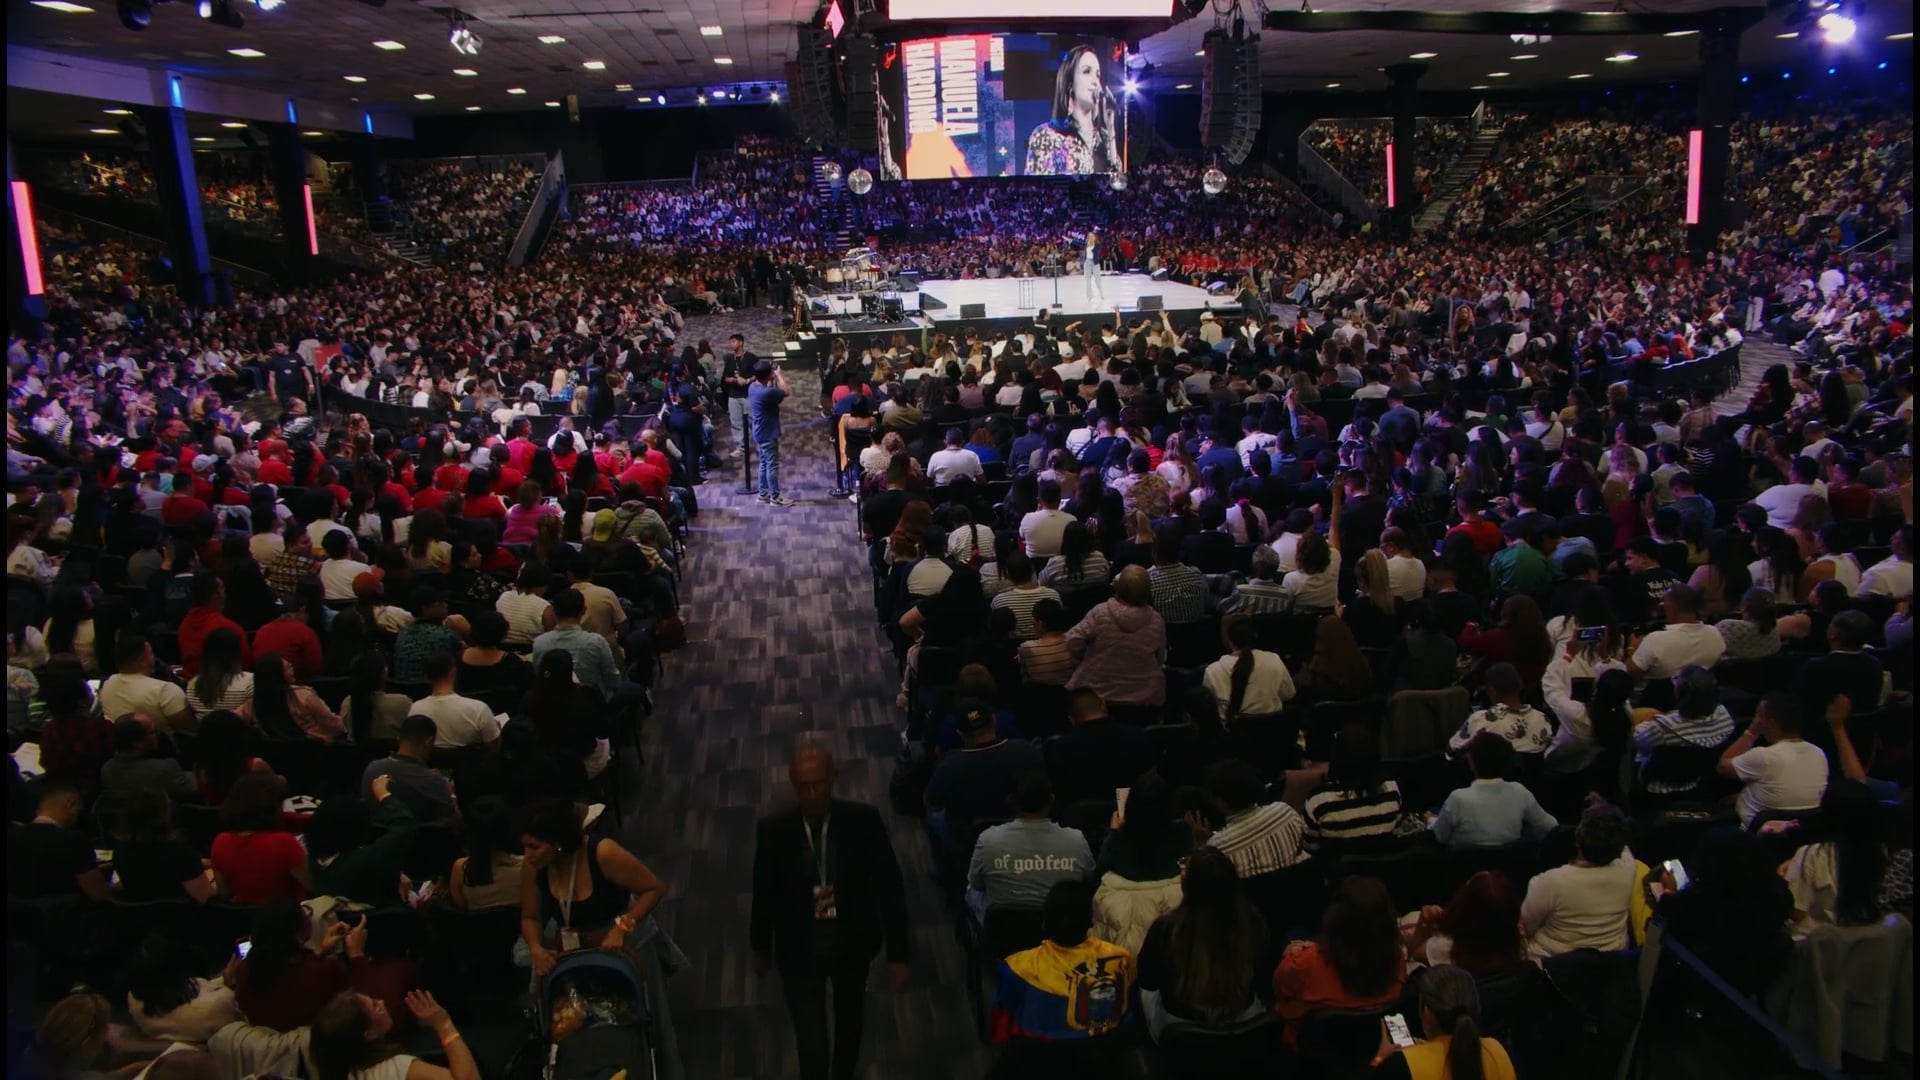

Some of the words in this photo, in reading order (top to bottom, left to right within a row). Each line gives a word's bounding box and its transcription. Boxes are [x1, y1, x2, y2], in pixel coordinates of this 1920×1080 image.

[905, 42, 938, 134] HARDING
[939, 39, 979, 137] MANUELA
[994, 853, 1011, 871] of
